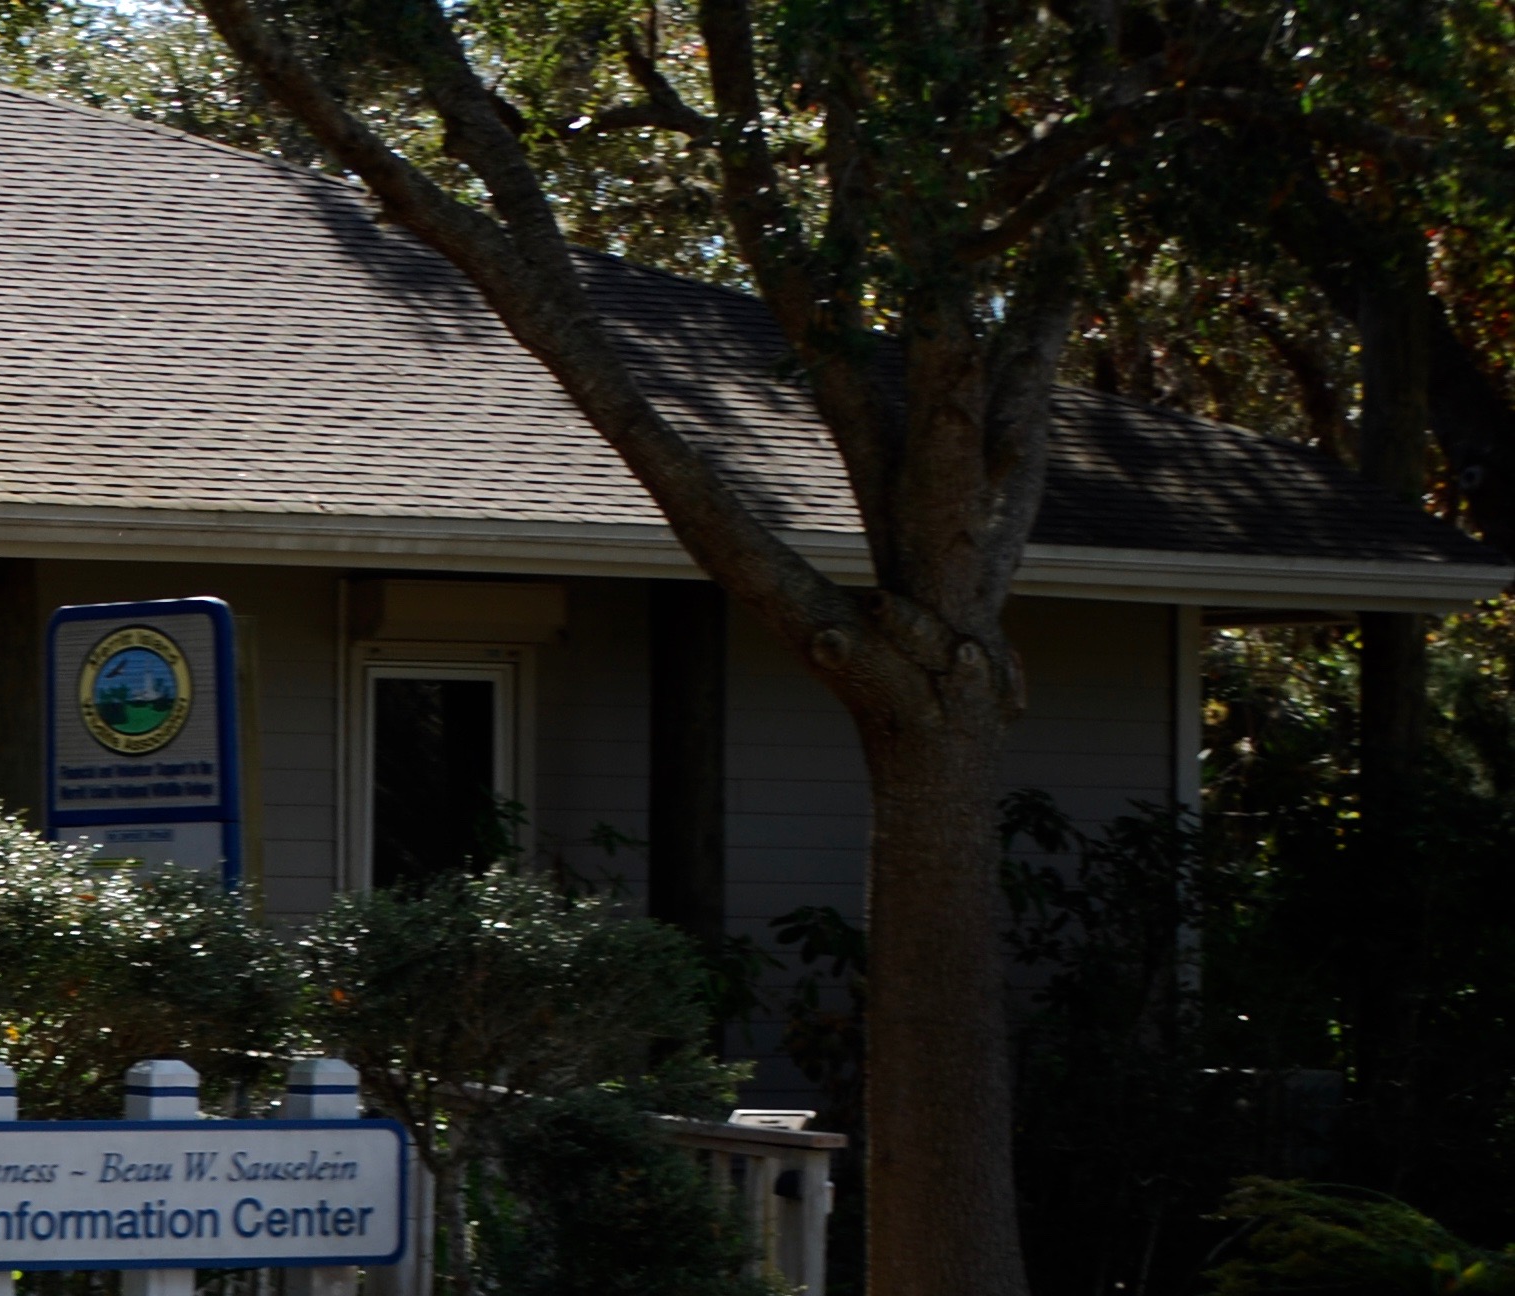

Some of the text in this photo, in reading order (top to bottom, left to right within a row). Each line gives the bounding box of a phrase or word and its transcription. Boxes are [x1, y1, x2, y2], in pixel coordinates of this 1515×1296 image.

[98, 1151, 173, 1183] Beau
[183, 1151, 219, 1182] W.
[226, 1150, 358, 1182] Sauselein
[234, 1197, 375, 1238] Center
